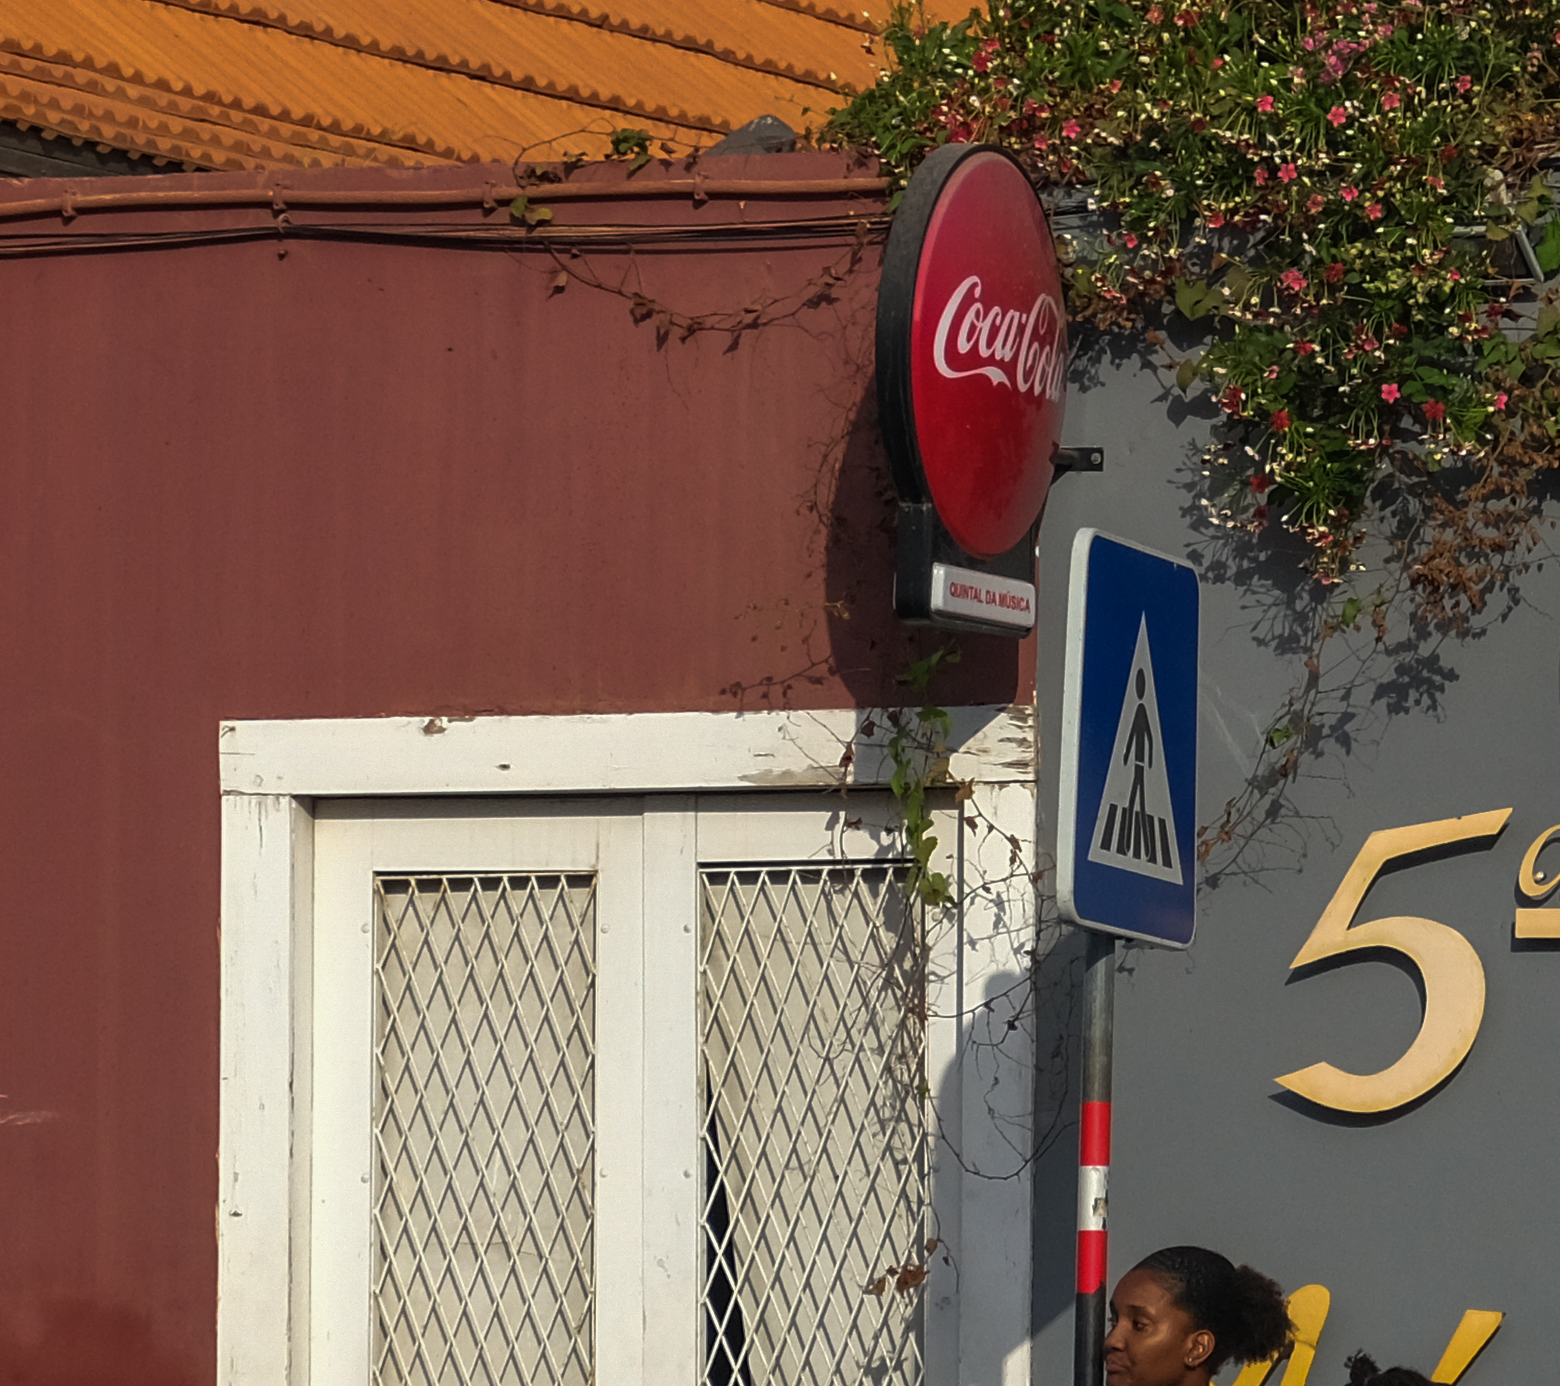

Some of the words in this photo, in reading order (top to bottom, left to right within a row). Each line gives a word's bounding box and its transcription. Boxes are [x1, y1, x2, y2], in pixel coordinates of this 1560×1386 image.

[950, 581, 985, 603] QUINTAL
[985, 590, 997, 606] DA
[999, 591, 1031, 614] MÚSICA
